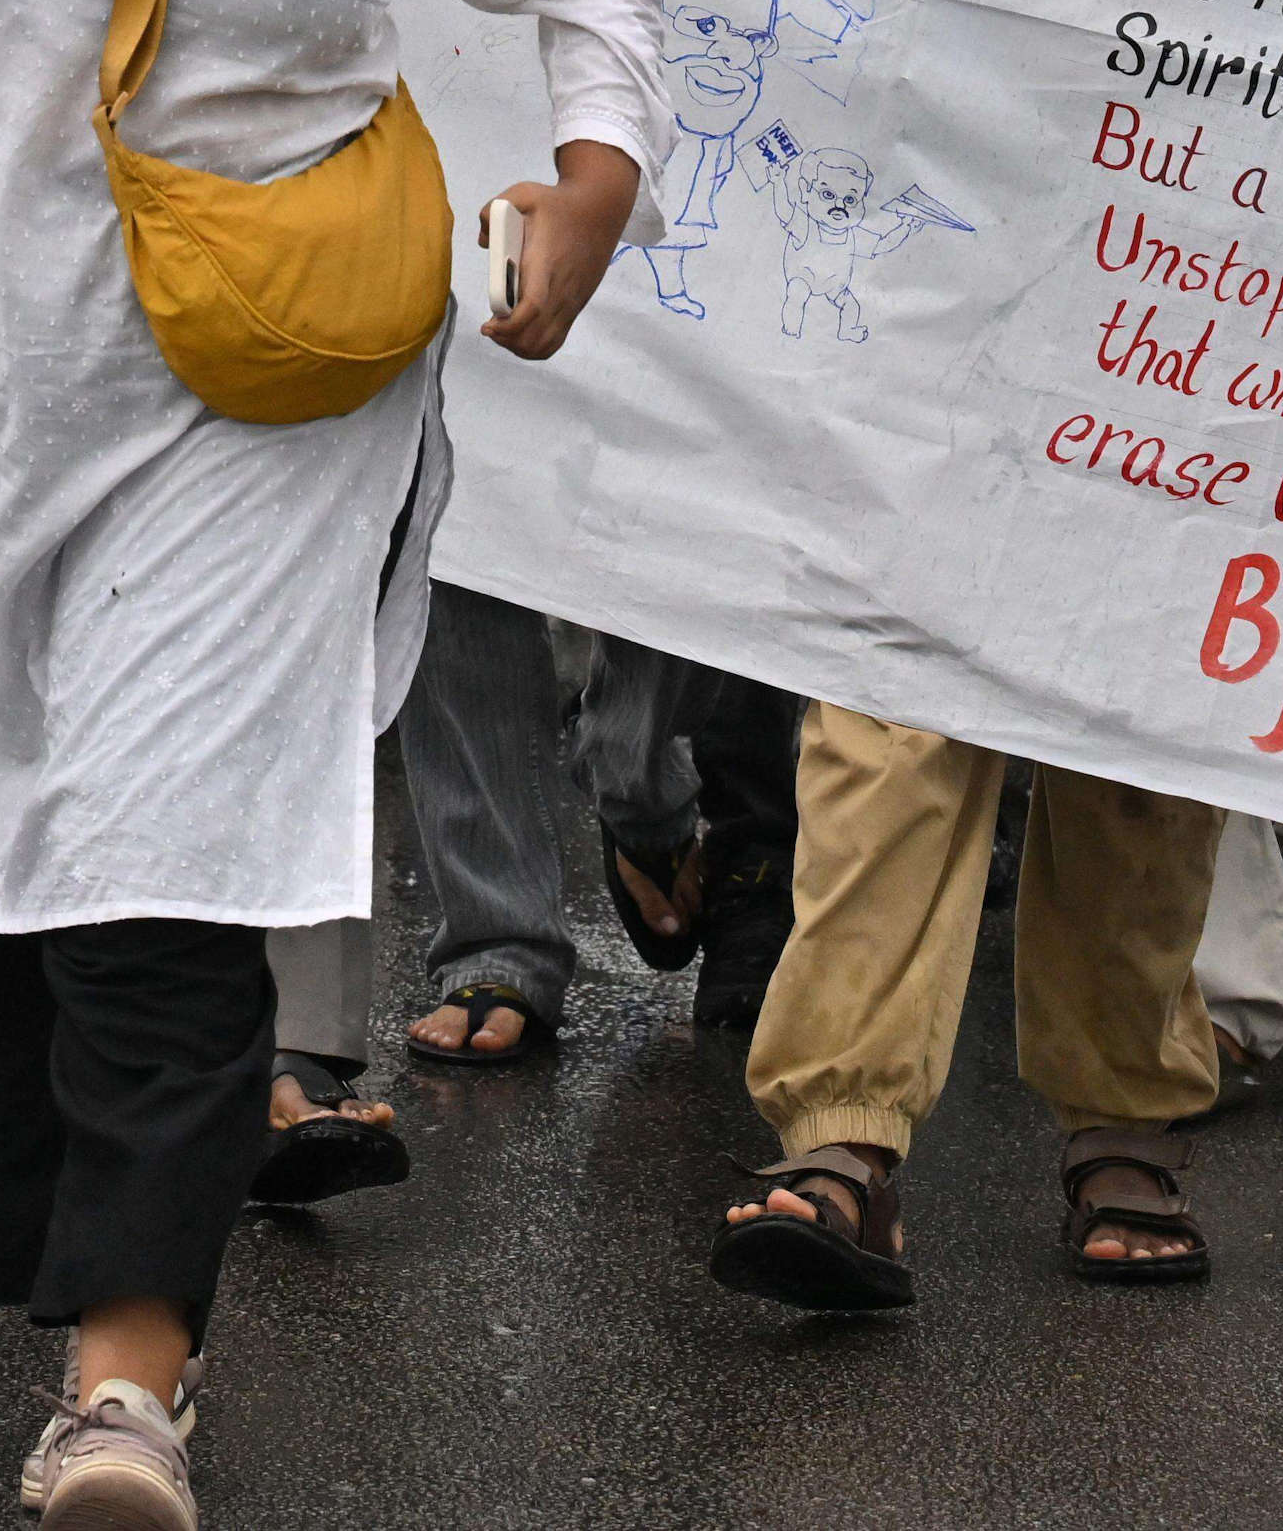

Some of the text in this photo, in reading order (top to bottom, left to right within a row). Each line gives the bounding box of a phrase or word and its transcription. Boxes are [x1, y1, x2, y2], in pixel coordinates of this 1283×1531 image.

[1092, 100, 1206, 191] But
[1232, 166, 1266, 214] a
[1097, 300, 1218, 396] that
[1046, 413, 1251, 506] erase
